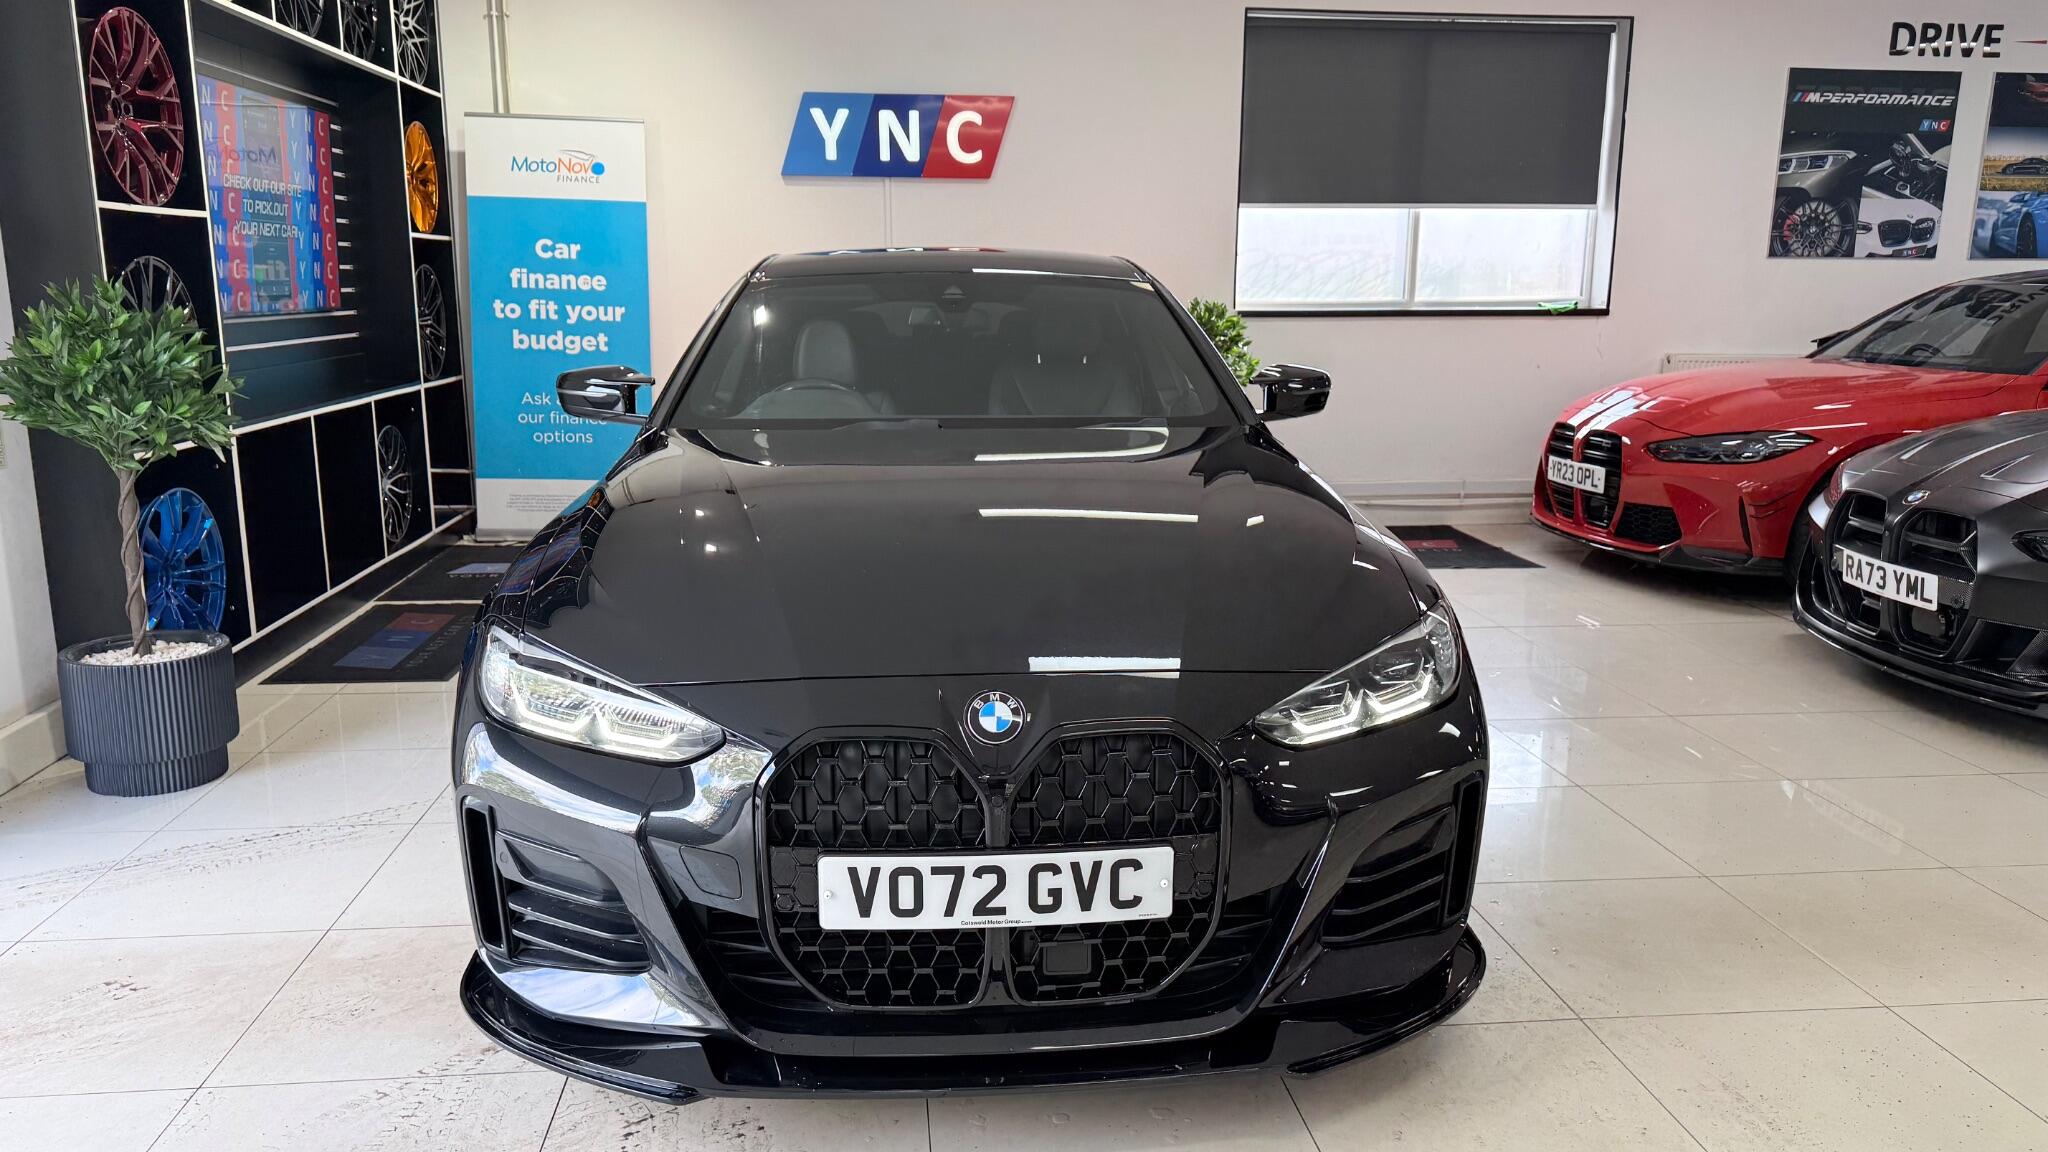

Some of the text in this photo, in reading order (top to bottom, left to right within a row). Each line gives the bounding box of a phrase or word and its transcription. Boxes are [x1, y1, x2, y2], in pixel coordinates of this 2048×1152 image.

[1889, 22, 2004, 58] DRIVE
[810, 107, 982, 164] YNC
[1922, 120, 1947, 131] YNC
[223, 173, 302, 198] CHECK OUT OUR SITE
[556, 175, 600, 184] FINANCE
[243, 198, 289, 217] TO PICK OUT
[236, 219, 258, 236] YOUR
[260, 222, 280, 237] NEXT
[535, 238, 581, 260] Car
[510, 268, 607, 291] finance
[493, 299, 625, 324] to fit your
[512, 329, 609, 355] budget
[521, 391, 551, 406] Ask
[518, 413, 544, 424] our
[533, 431, 593, 445] options
[1551, 459, 1599, 489] YR23 OPL
[1845, 554, 1933, 604] RA73 YML
[974, 693, 1017, 709] BMW
[847, 858, 1143, 918] VO72 GVC
